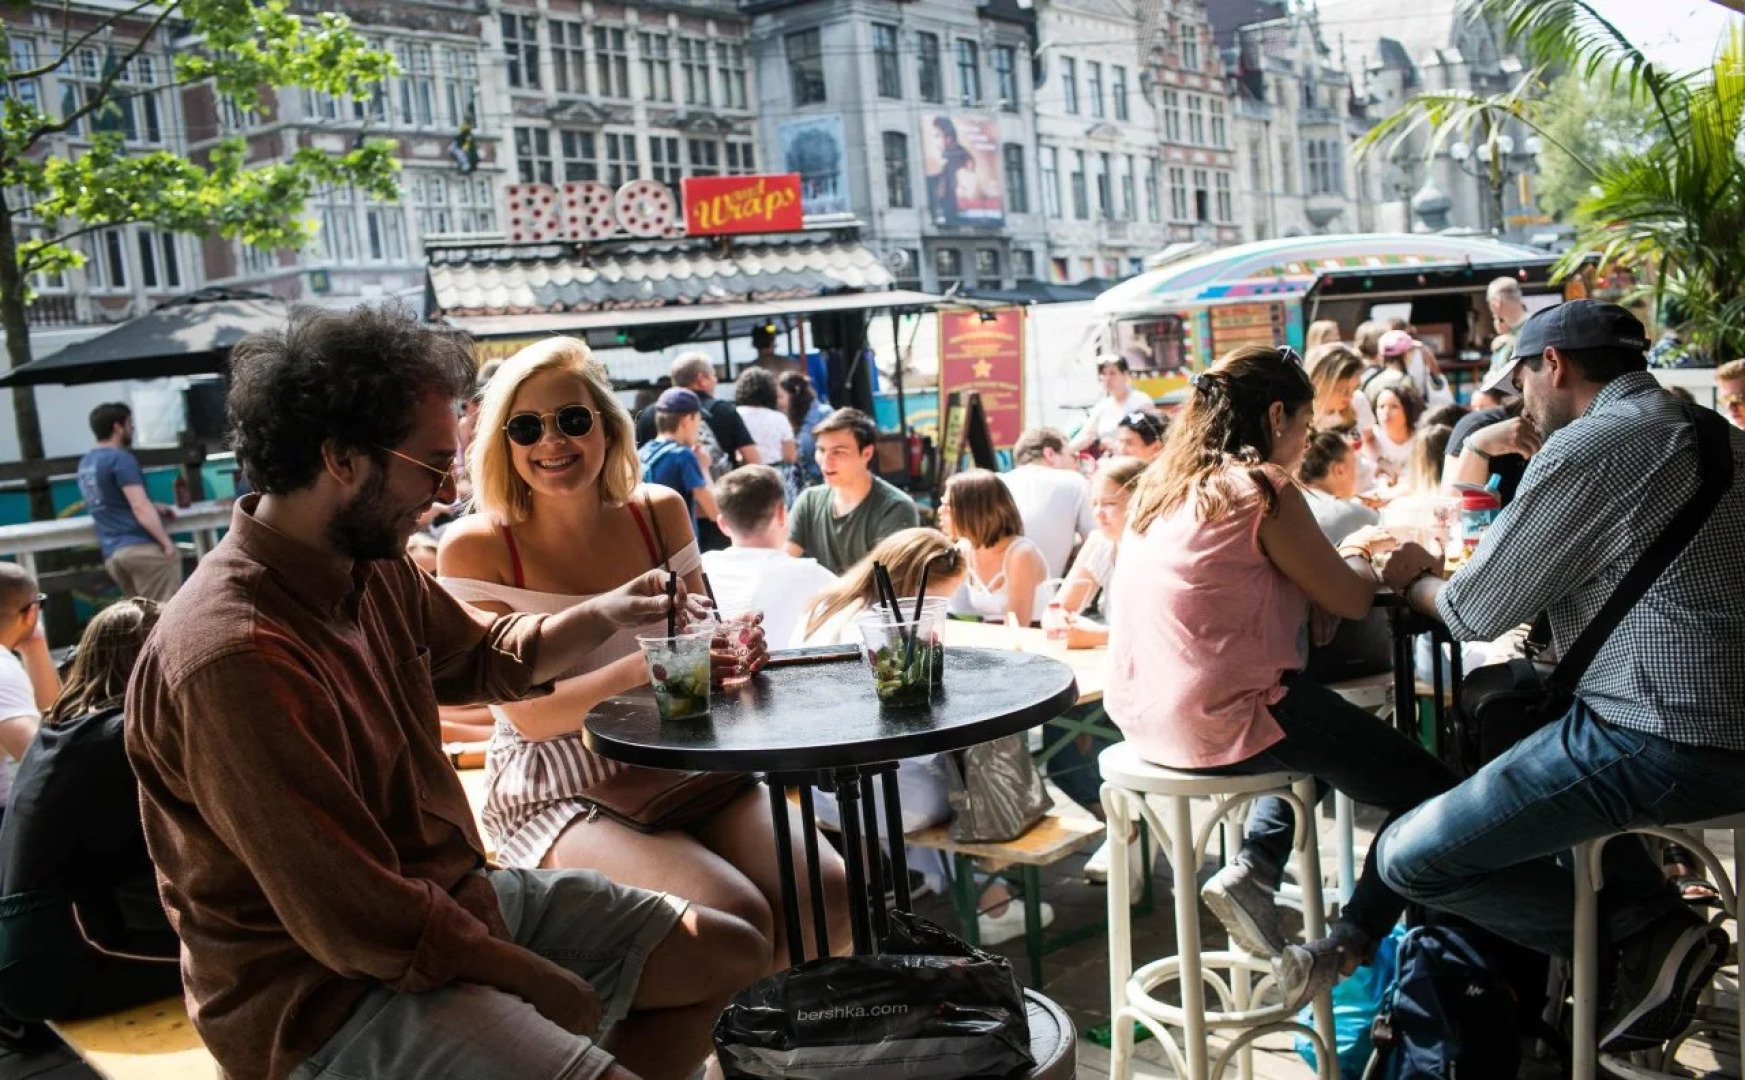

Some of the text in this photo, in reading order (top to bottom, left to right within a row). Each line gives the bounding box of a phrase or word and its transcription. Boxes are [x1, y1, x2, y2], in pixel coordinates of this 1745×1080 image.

[505, 179, 684, 243] BBQ
[693, 188, 796, 229] Wraps
[797, 1004, 908, 1021] bershka.com
